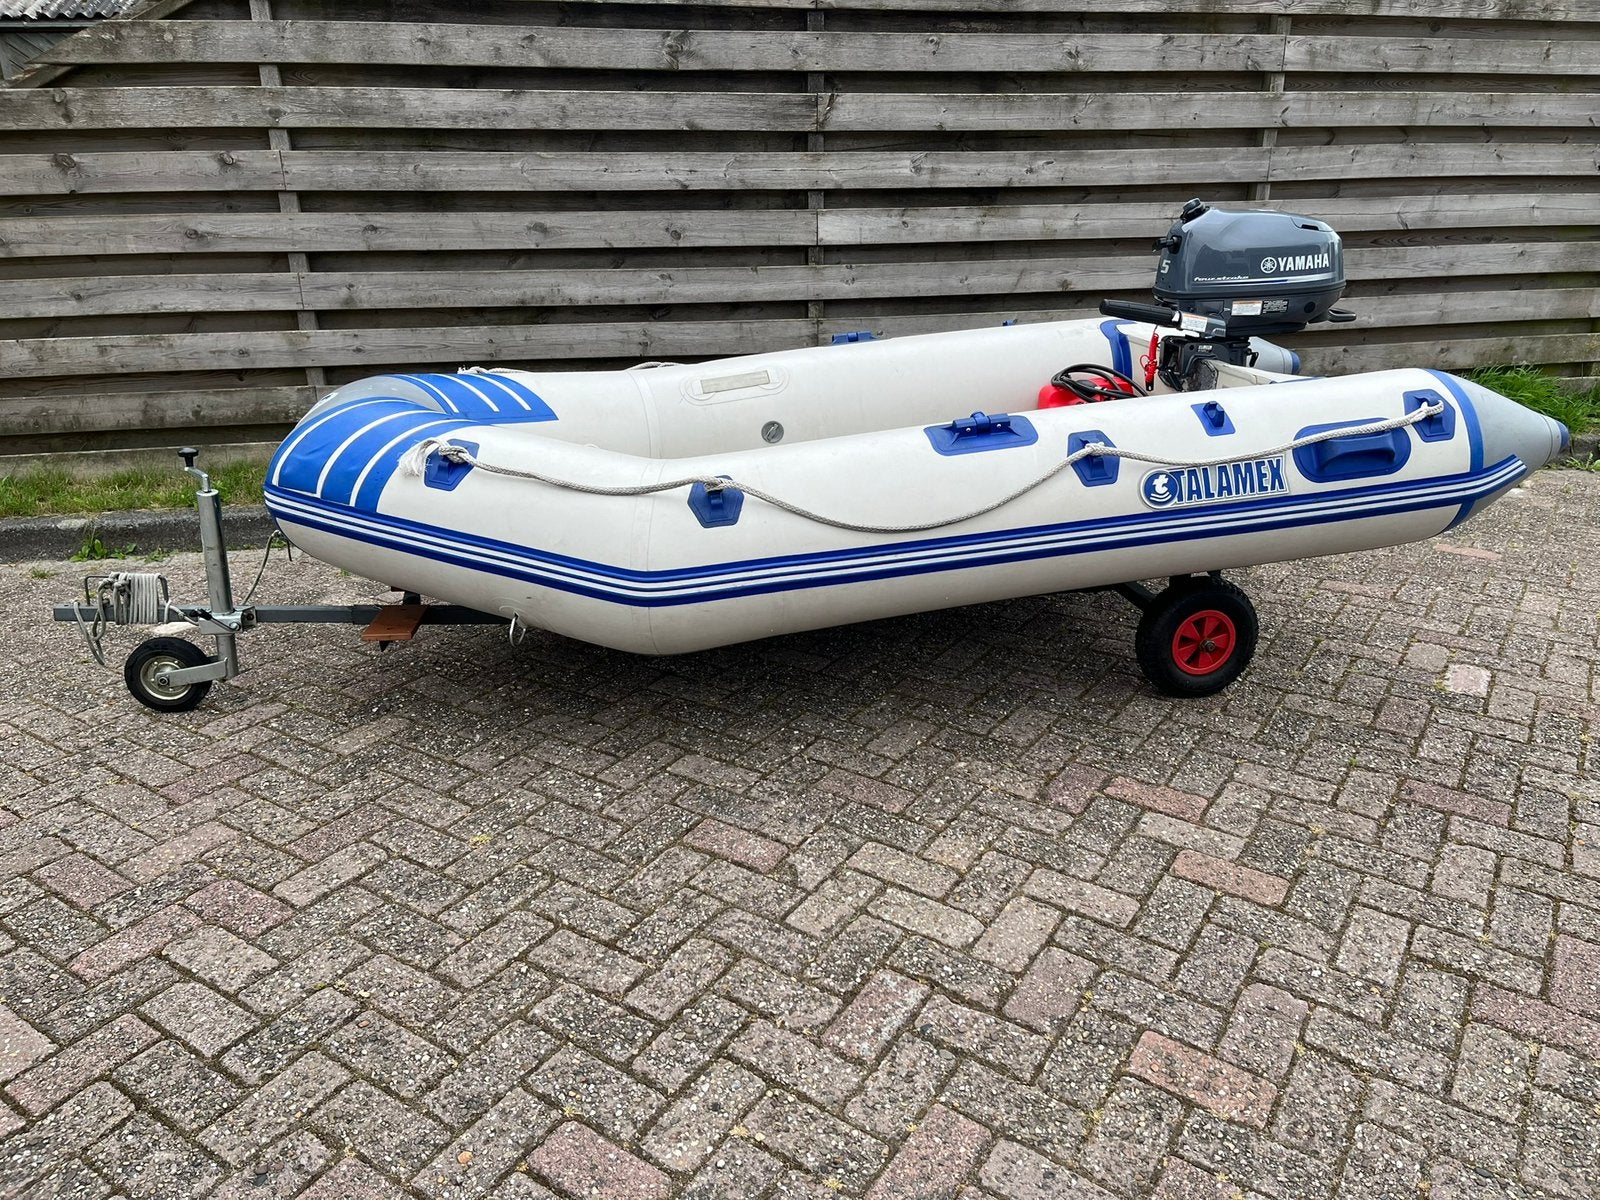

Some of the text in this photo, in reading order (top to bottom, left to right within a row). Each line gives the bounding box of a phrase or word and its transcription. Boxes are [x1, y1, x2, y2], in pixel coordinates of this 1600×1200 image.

[1160, 259, 1171, 274] 5
[1278, 253, 1329, 272] YAMAHA
[1169, 458, 1286, 502] TALAMEX
